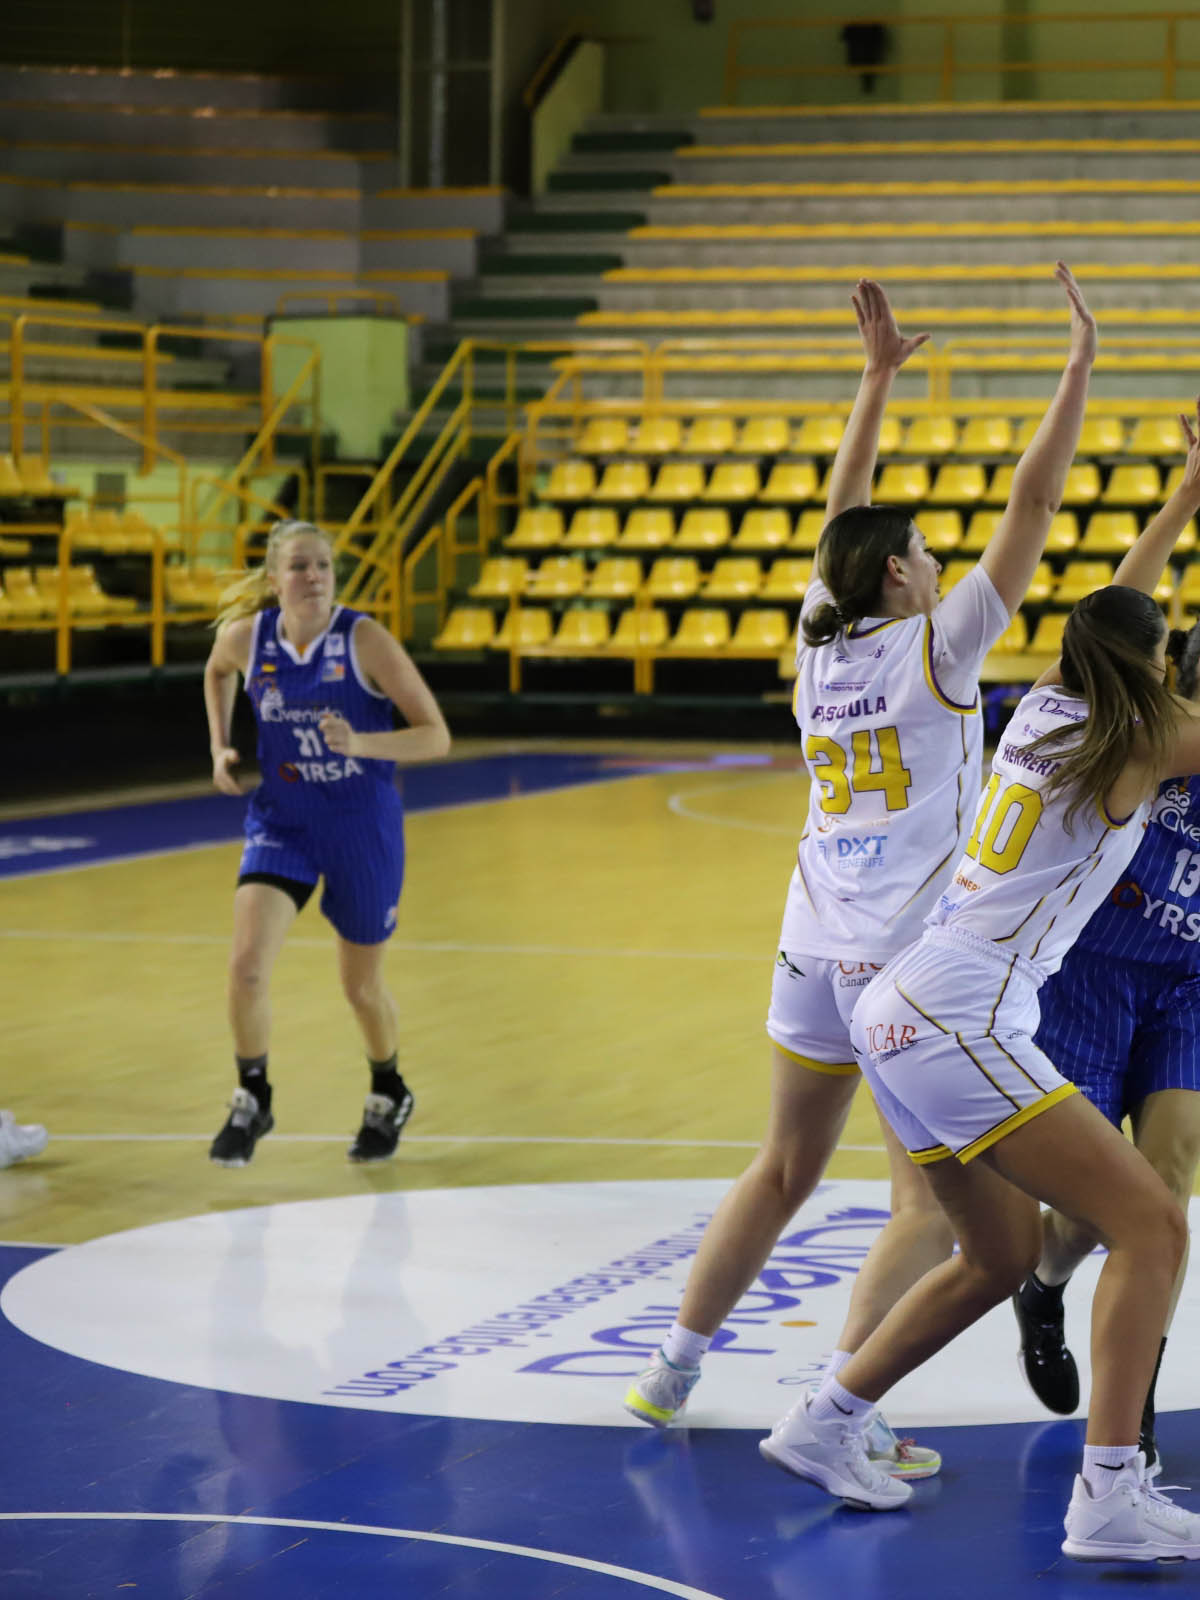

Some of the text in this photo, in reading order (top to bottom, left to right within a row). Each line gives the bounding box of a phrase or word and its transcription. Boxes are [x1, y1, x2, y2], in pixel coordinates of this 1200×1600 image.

[806, 726, 913, 814] 34
[837, 835, 888, 857] DXT
[965, 772, 1043, 875] 10
